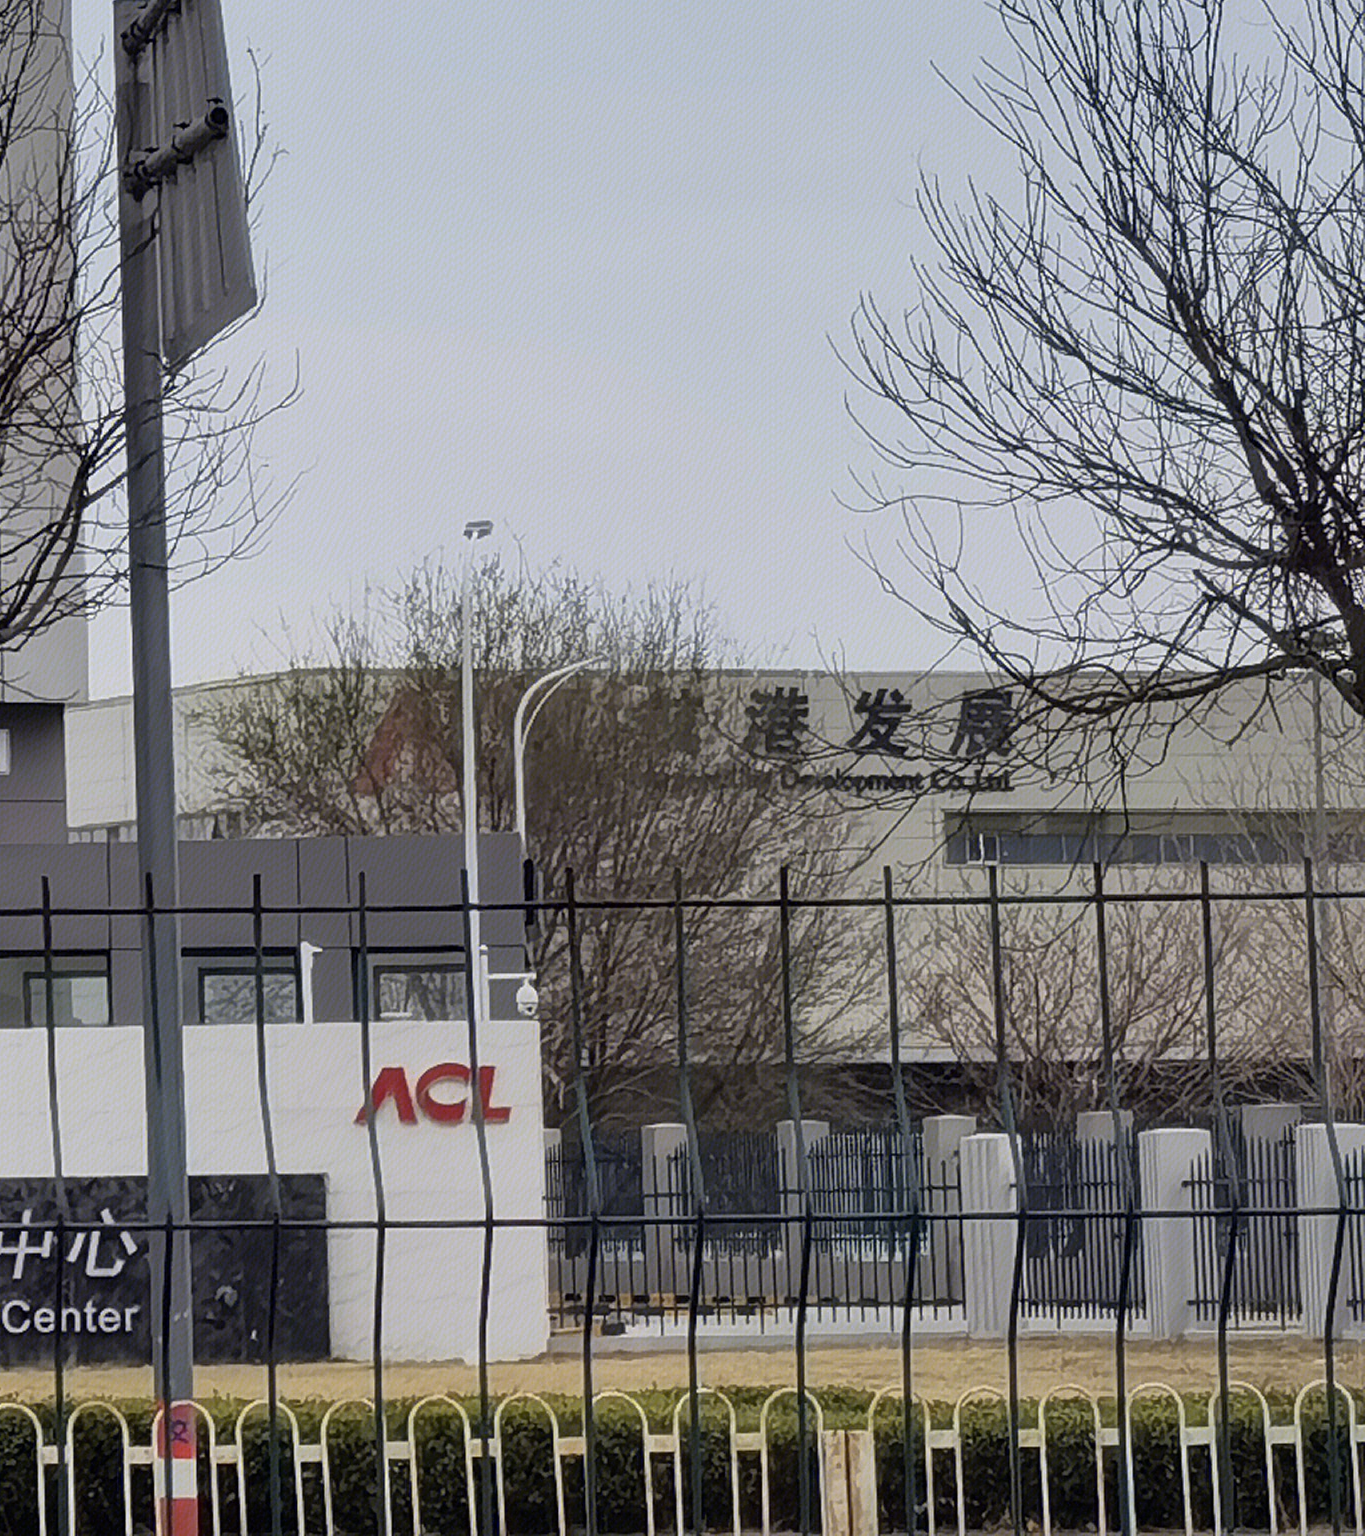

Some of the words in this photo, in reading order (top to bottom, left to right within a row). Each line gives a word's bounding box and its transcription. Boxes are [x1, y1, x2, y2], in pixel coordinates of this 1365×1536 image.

[643, 686, 1015, 758] 港发展
[353, 1062, 512, 1126] ACL
[1, 1299, 141, 1334] Center
